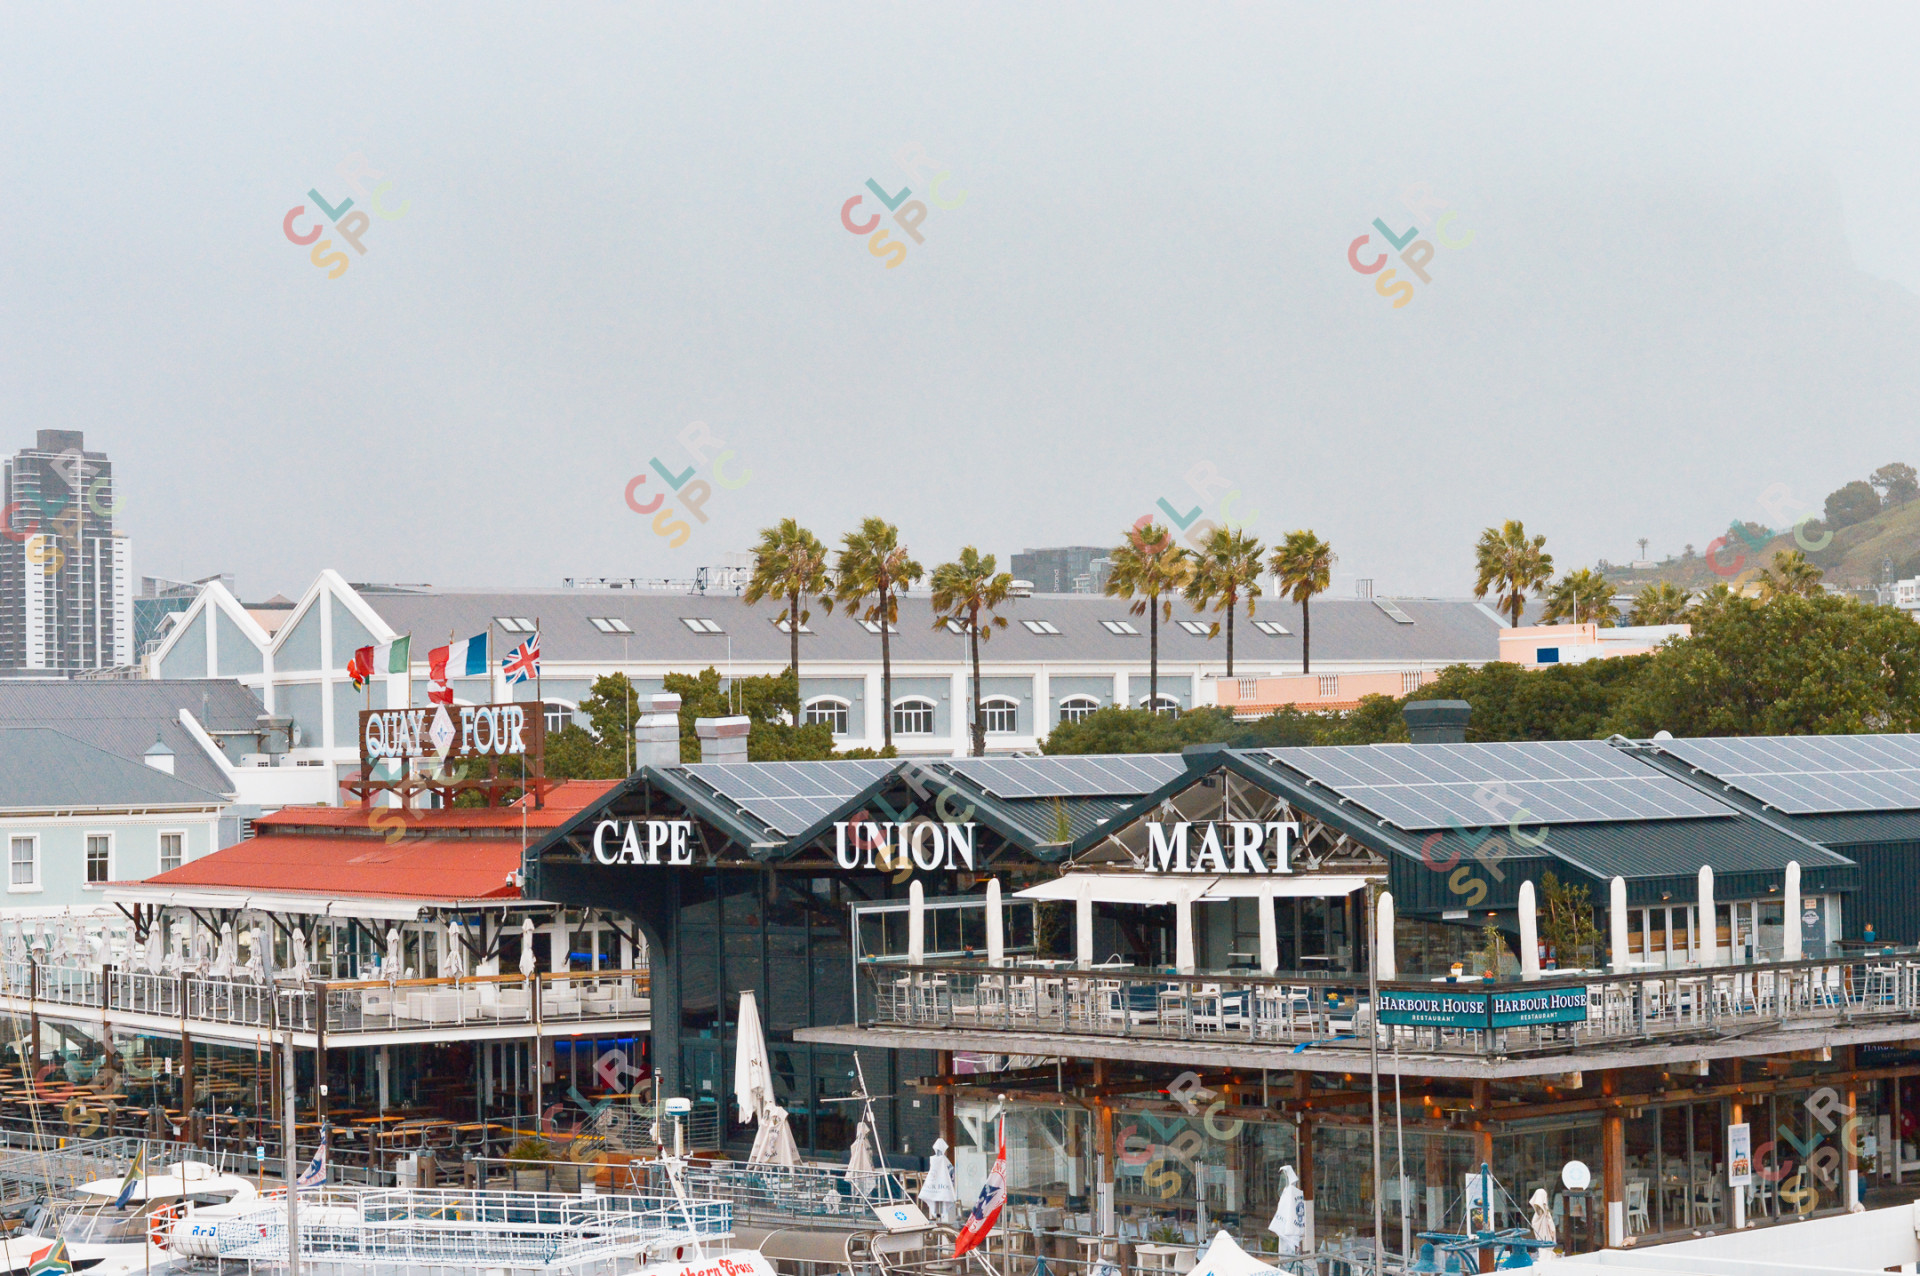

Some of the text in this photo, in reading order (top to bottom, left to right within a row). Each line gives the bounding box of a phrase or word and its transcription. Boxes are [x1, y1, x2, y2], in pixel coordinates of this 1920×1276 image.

[365, 705, 526, 758] QUAY FOUR
[593, 820, 1301, 873] CAPE UNION MART
[1380, 996, 1485, 1014] HARBOUR HOUSE
[1494, 994, 1586, 1014] HARBOUR HOUSE
[1411, 1014, 1455, 1022] RESTAURANT
[1520, 1012, 1558, 1021] RESTAURANT
